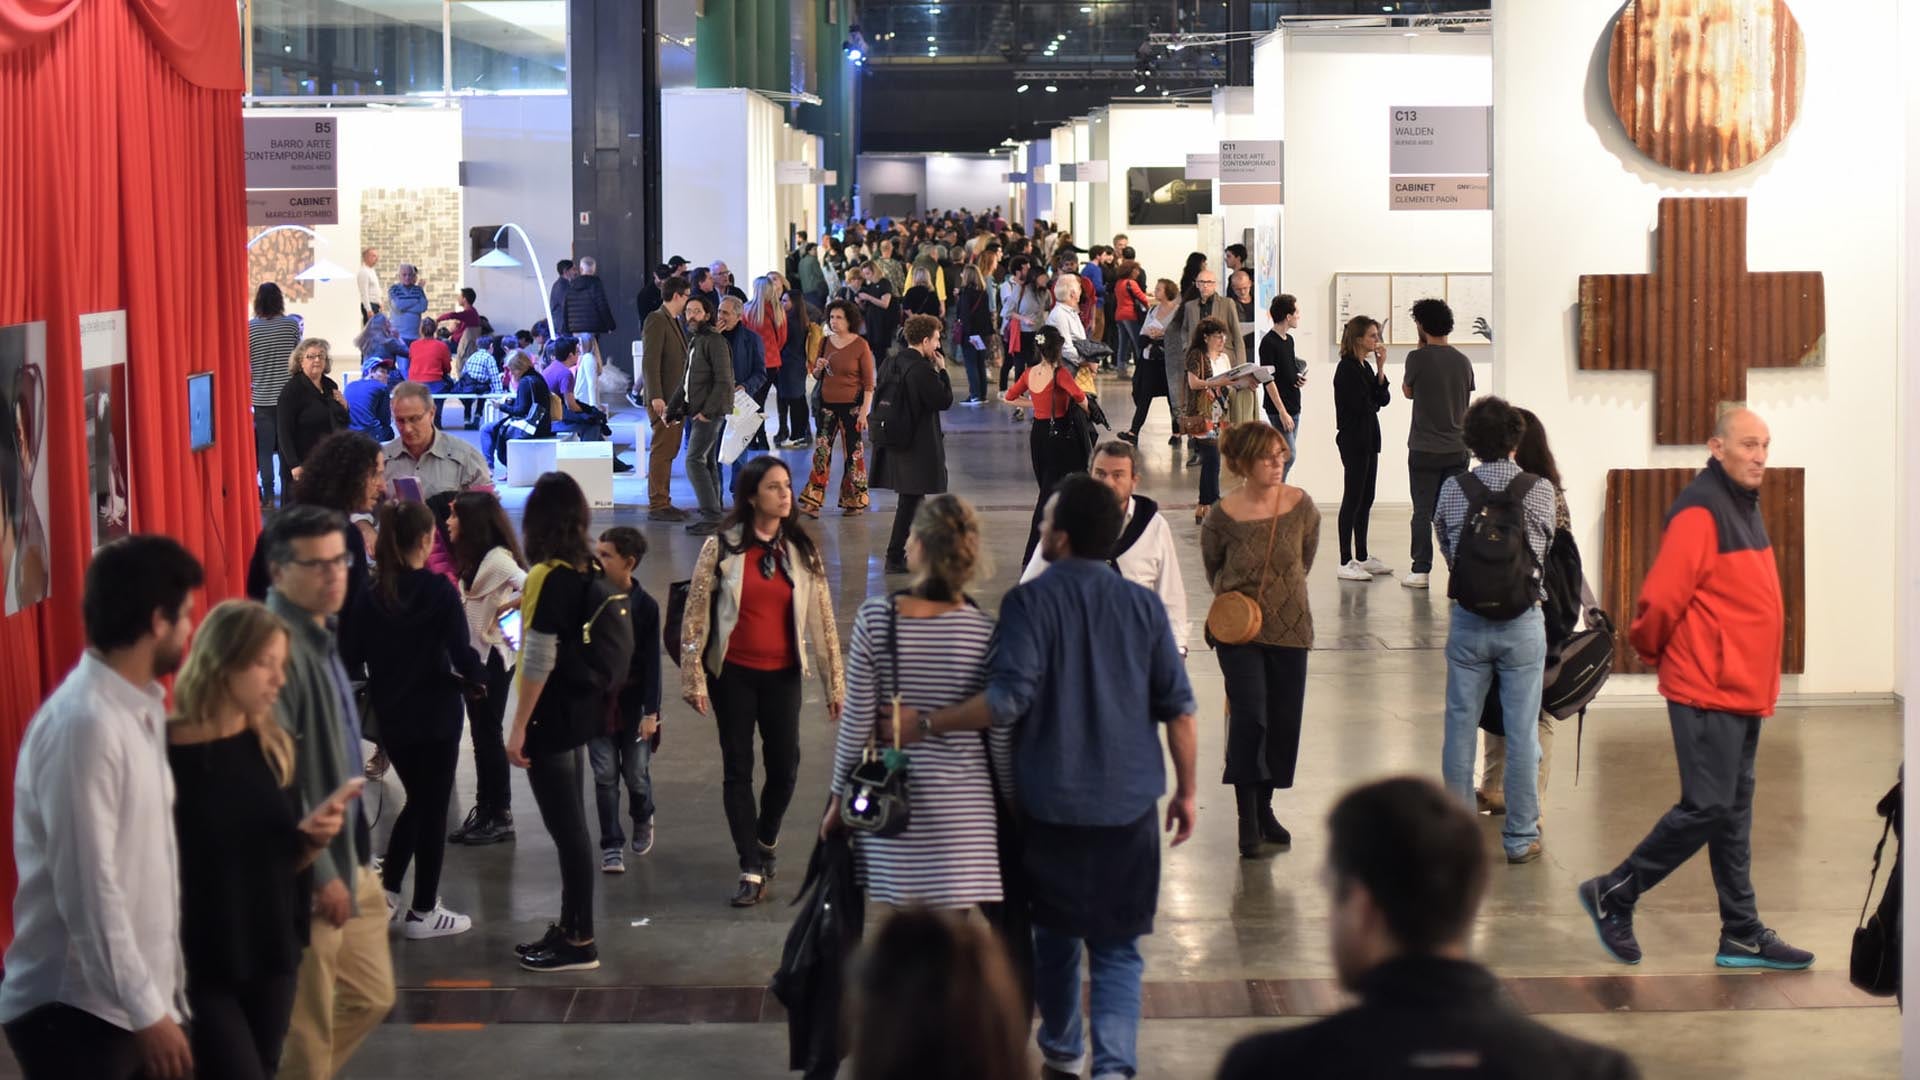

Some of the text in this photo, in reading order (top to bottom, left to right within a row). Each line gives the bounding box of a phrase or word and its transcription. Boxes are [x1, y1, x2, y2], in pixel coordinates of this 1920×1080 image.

[1395, 111, 1417, 121] C13
[315, 122, 331, 133] B5
[1395, 127, 1434, 136] WALDEN
[271, 140, 332, 149] BARRO ARTE
[1395, 184, 1436, 192] CABINET
[290, 197, 331, 206] CABINET
[1395, 196, 1435, 204] CLEMENTE
[265, 210, 332, 219] MARCELO POMBO
